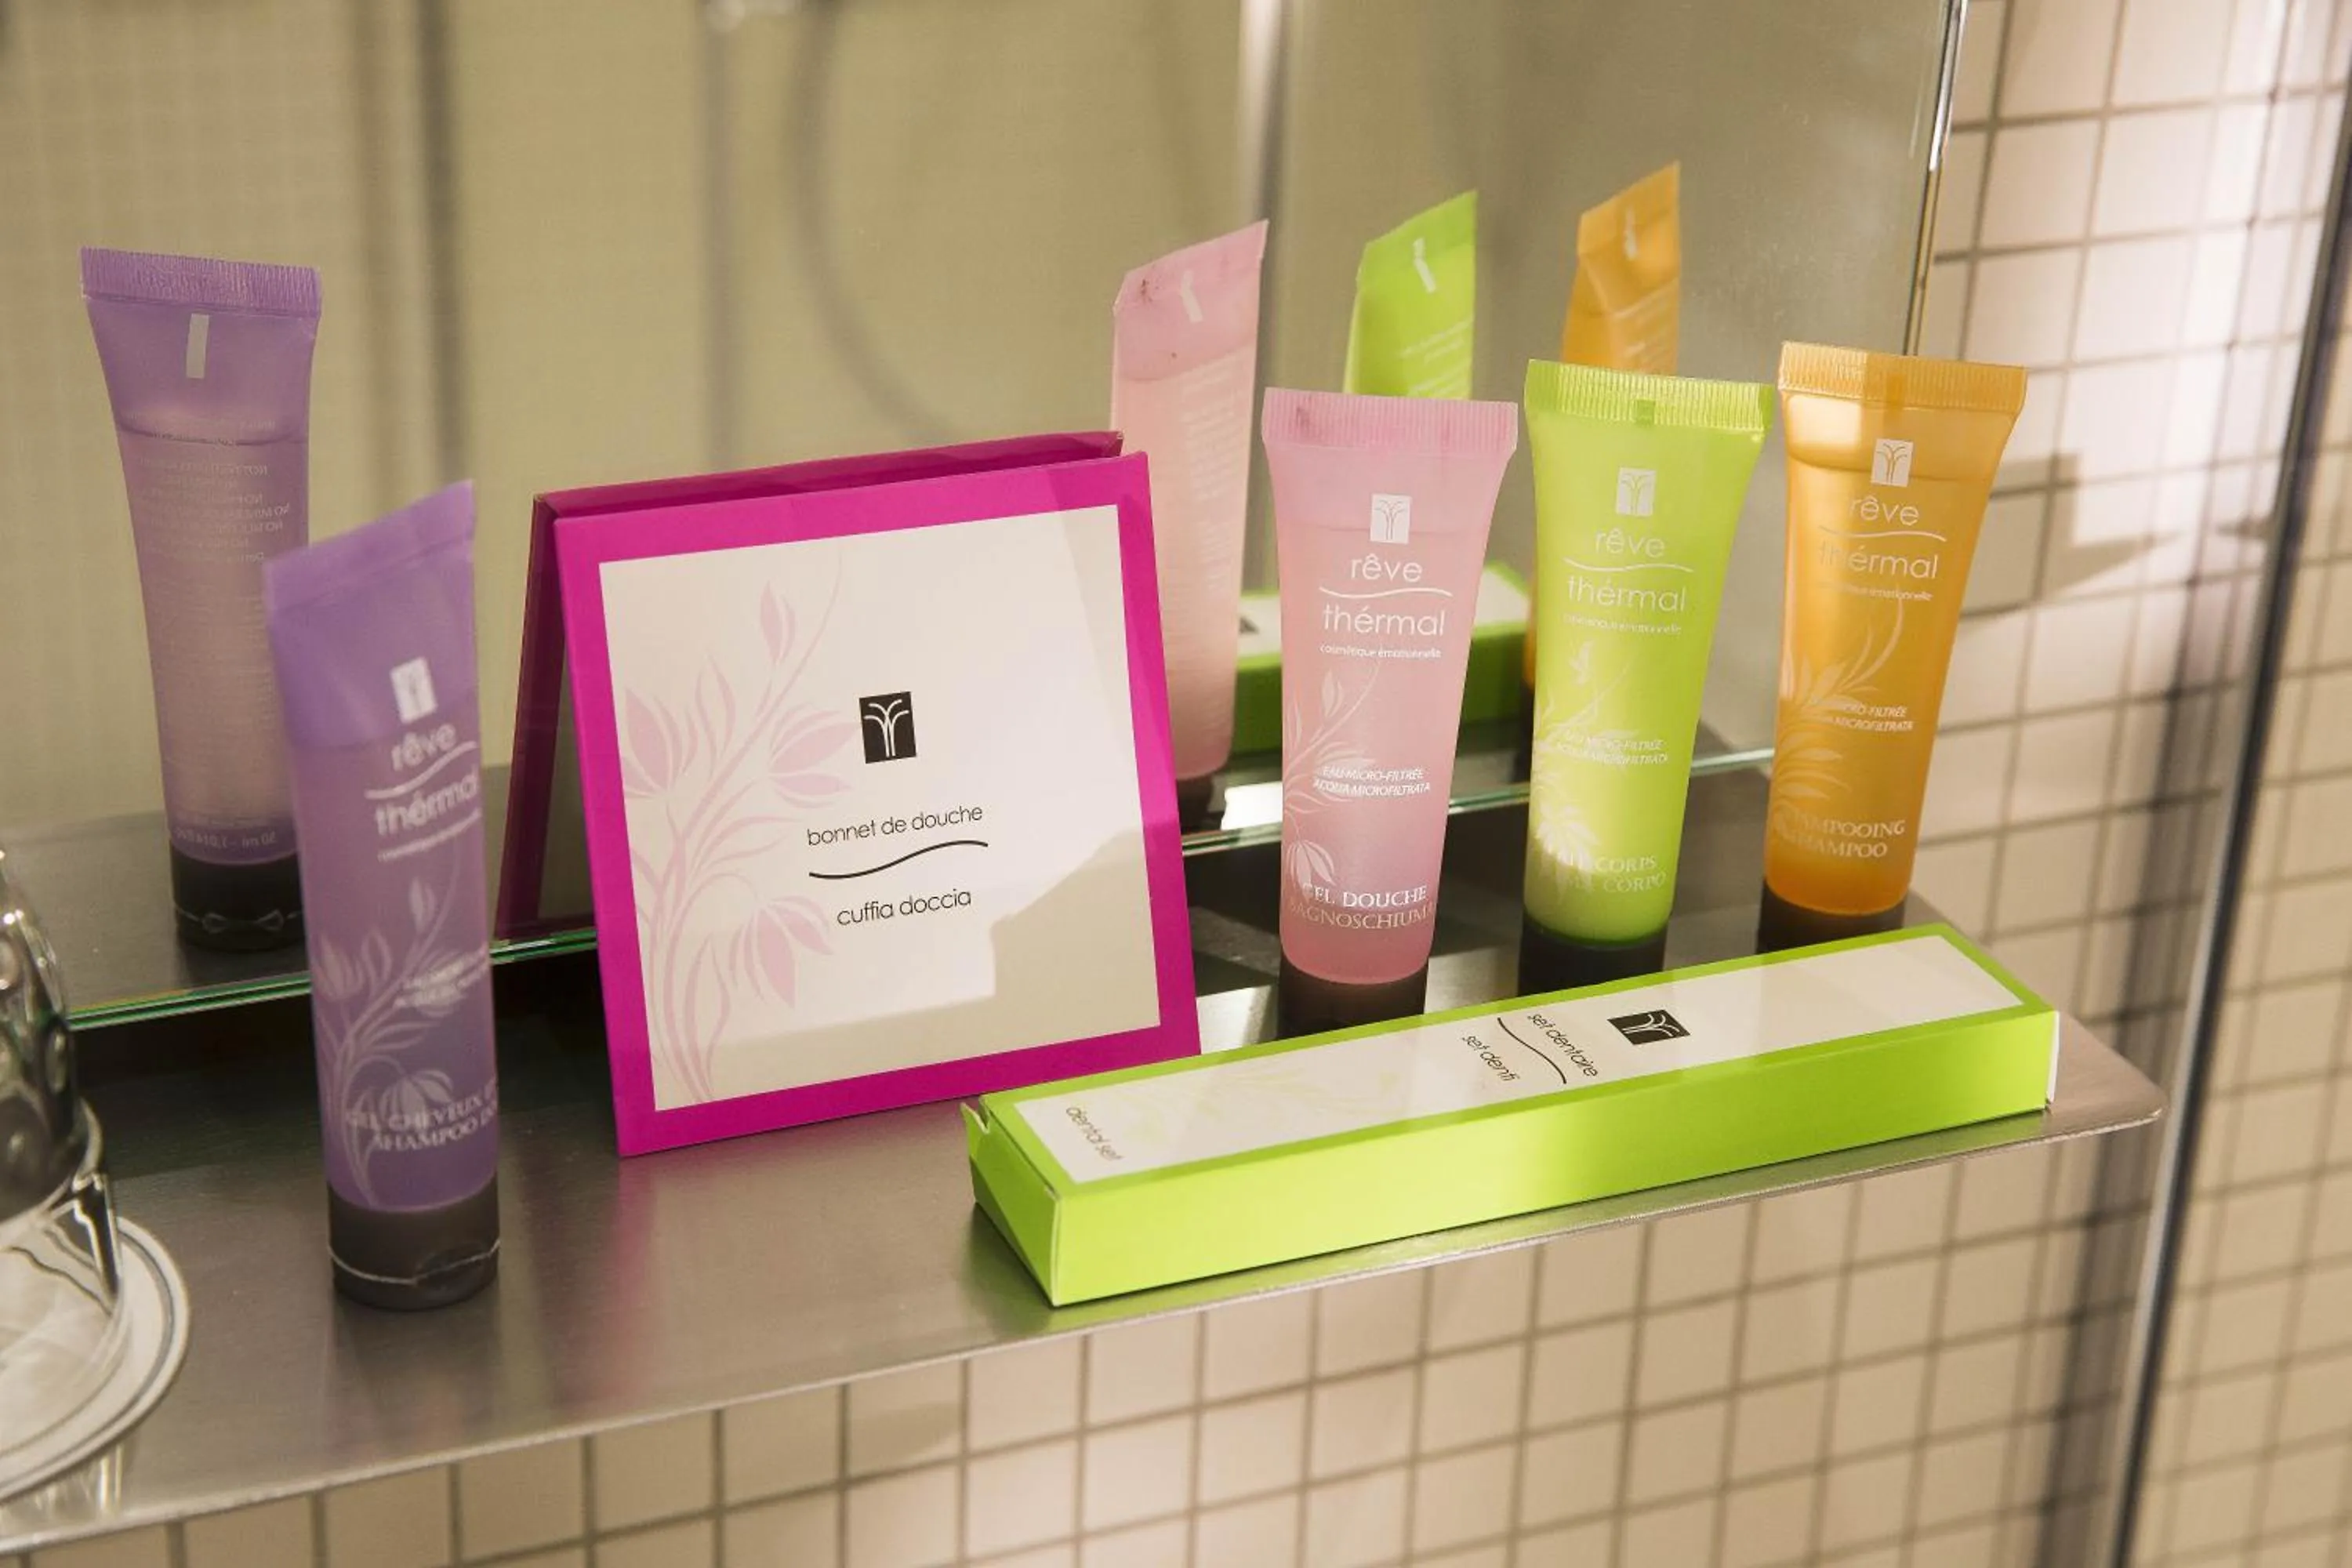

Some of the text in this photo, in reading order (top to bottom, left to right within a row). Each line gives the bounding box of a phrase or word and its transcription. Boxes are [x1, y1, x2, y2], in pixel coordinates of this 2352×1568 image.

[1849, 495, 1919, 526] rêve
[1595, 528, 1665, 557] rêve
[1350, 553, 1423, 582] rêve
[1567, 575, 1687, 612] thérmal
[1323, 604, 1446, 637] thérmal
[807, 805, 983, 846] bonnet de douche
[1594, 855, 1657, 873] CORPS
[1343, 884, 1427, 909] DOUCHE
[1603, 872, 1667, 893] CORPO
[837, 888, 972, 926] cuffia doccia
[1461, 1035, 1520, 1082] set denti
[1527, 1012, 1599, 1077] set dentaire
